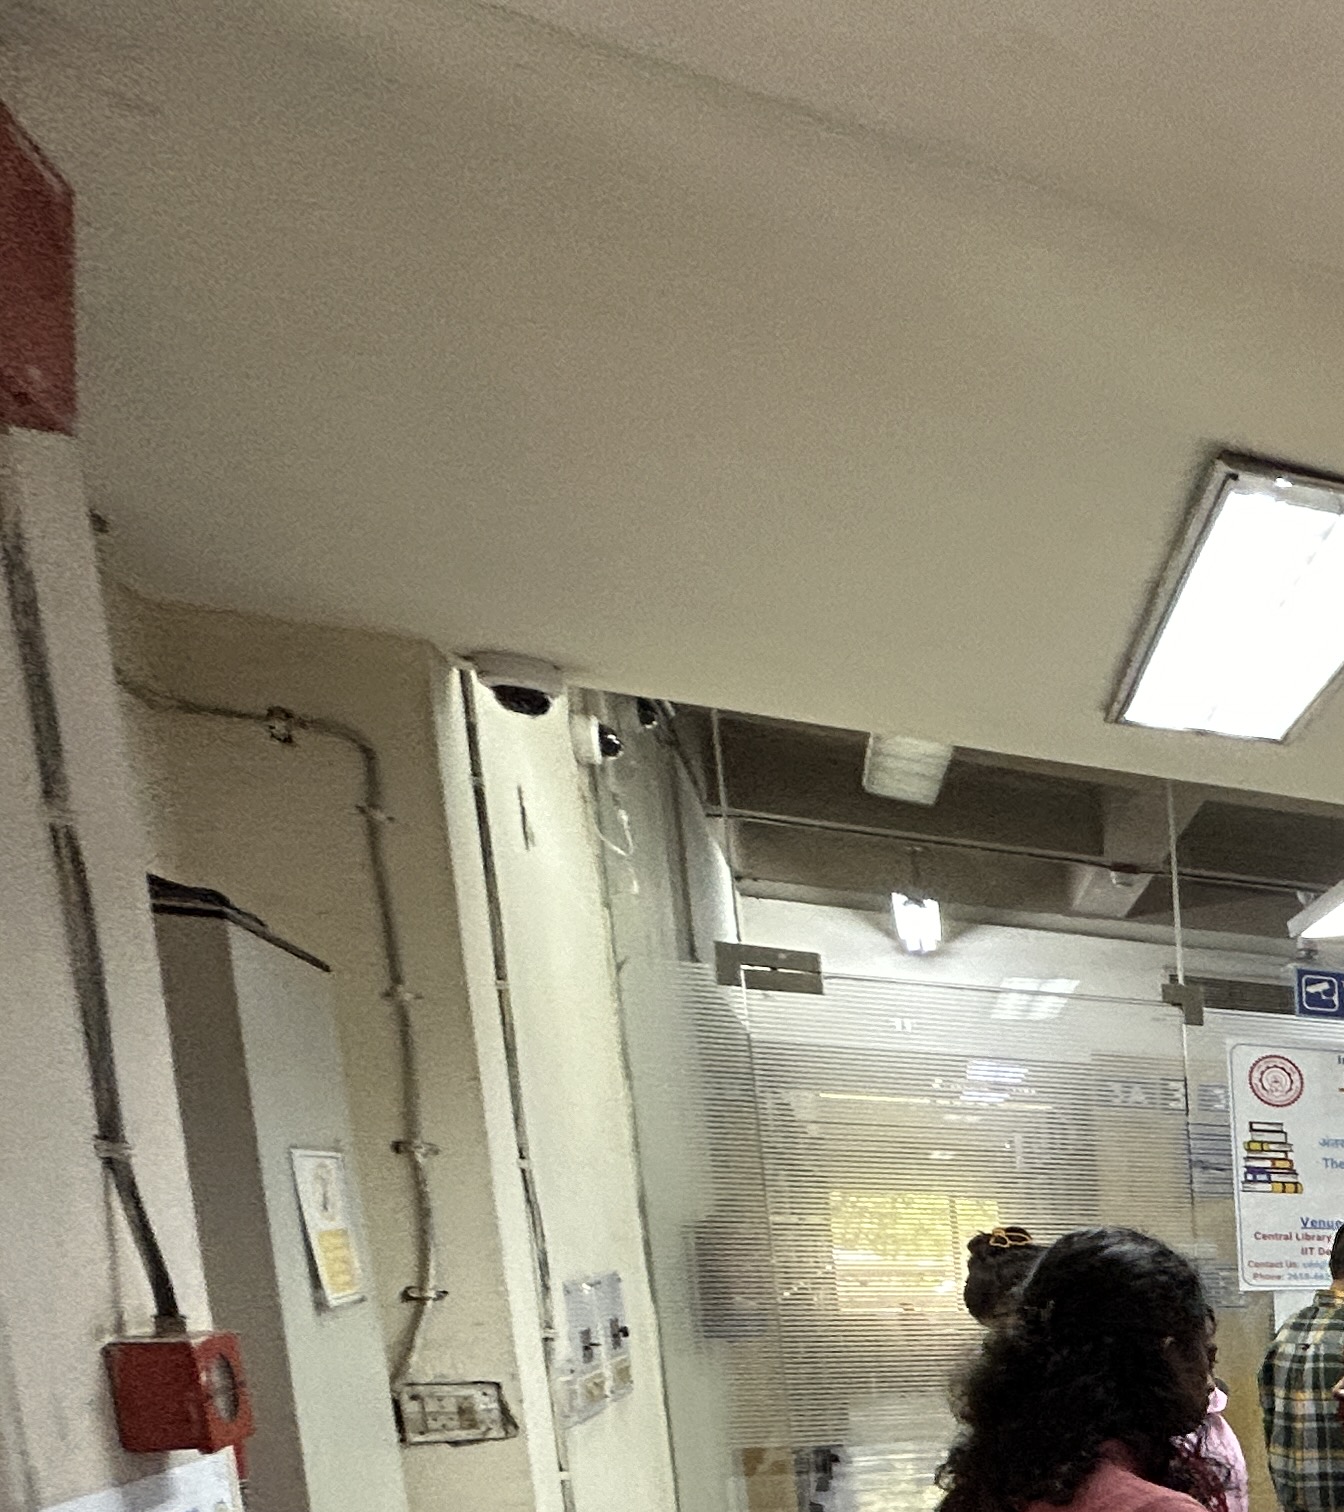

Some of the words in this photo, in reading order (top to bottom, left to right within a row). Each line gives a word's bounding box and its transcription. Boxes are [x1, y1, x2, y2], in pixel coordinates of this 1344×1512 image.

[1254, 1231, 1293, 1241] Central
[1295, 1232, 1332, 1244] Library
[1300, 1247, 1314, 1256] IIT
